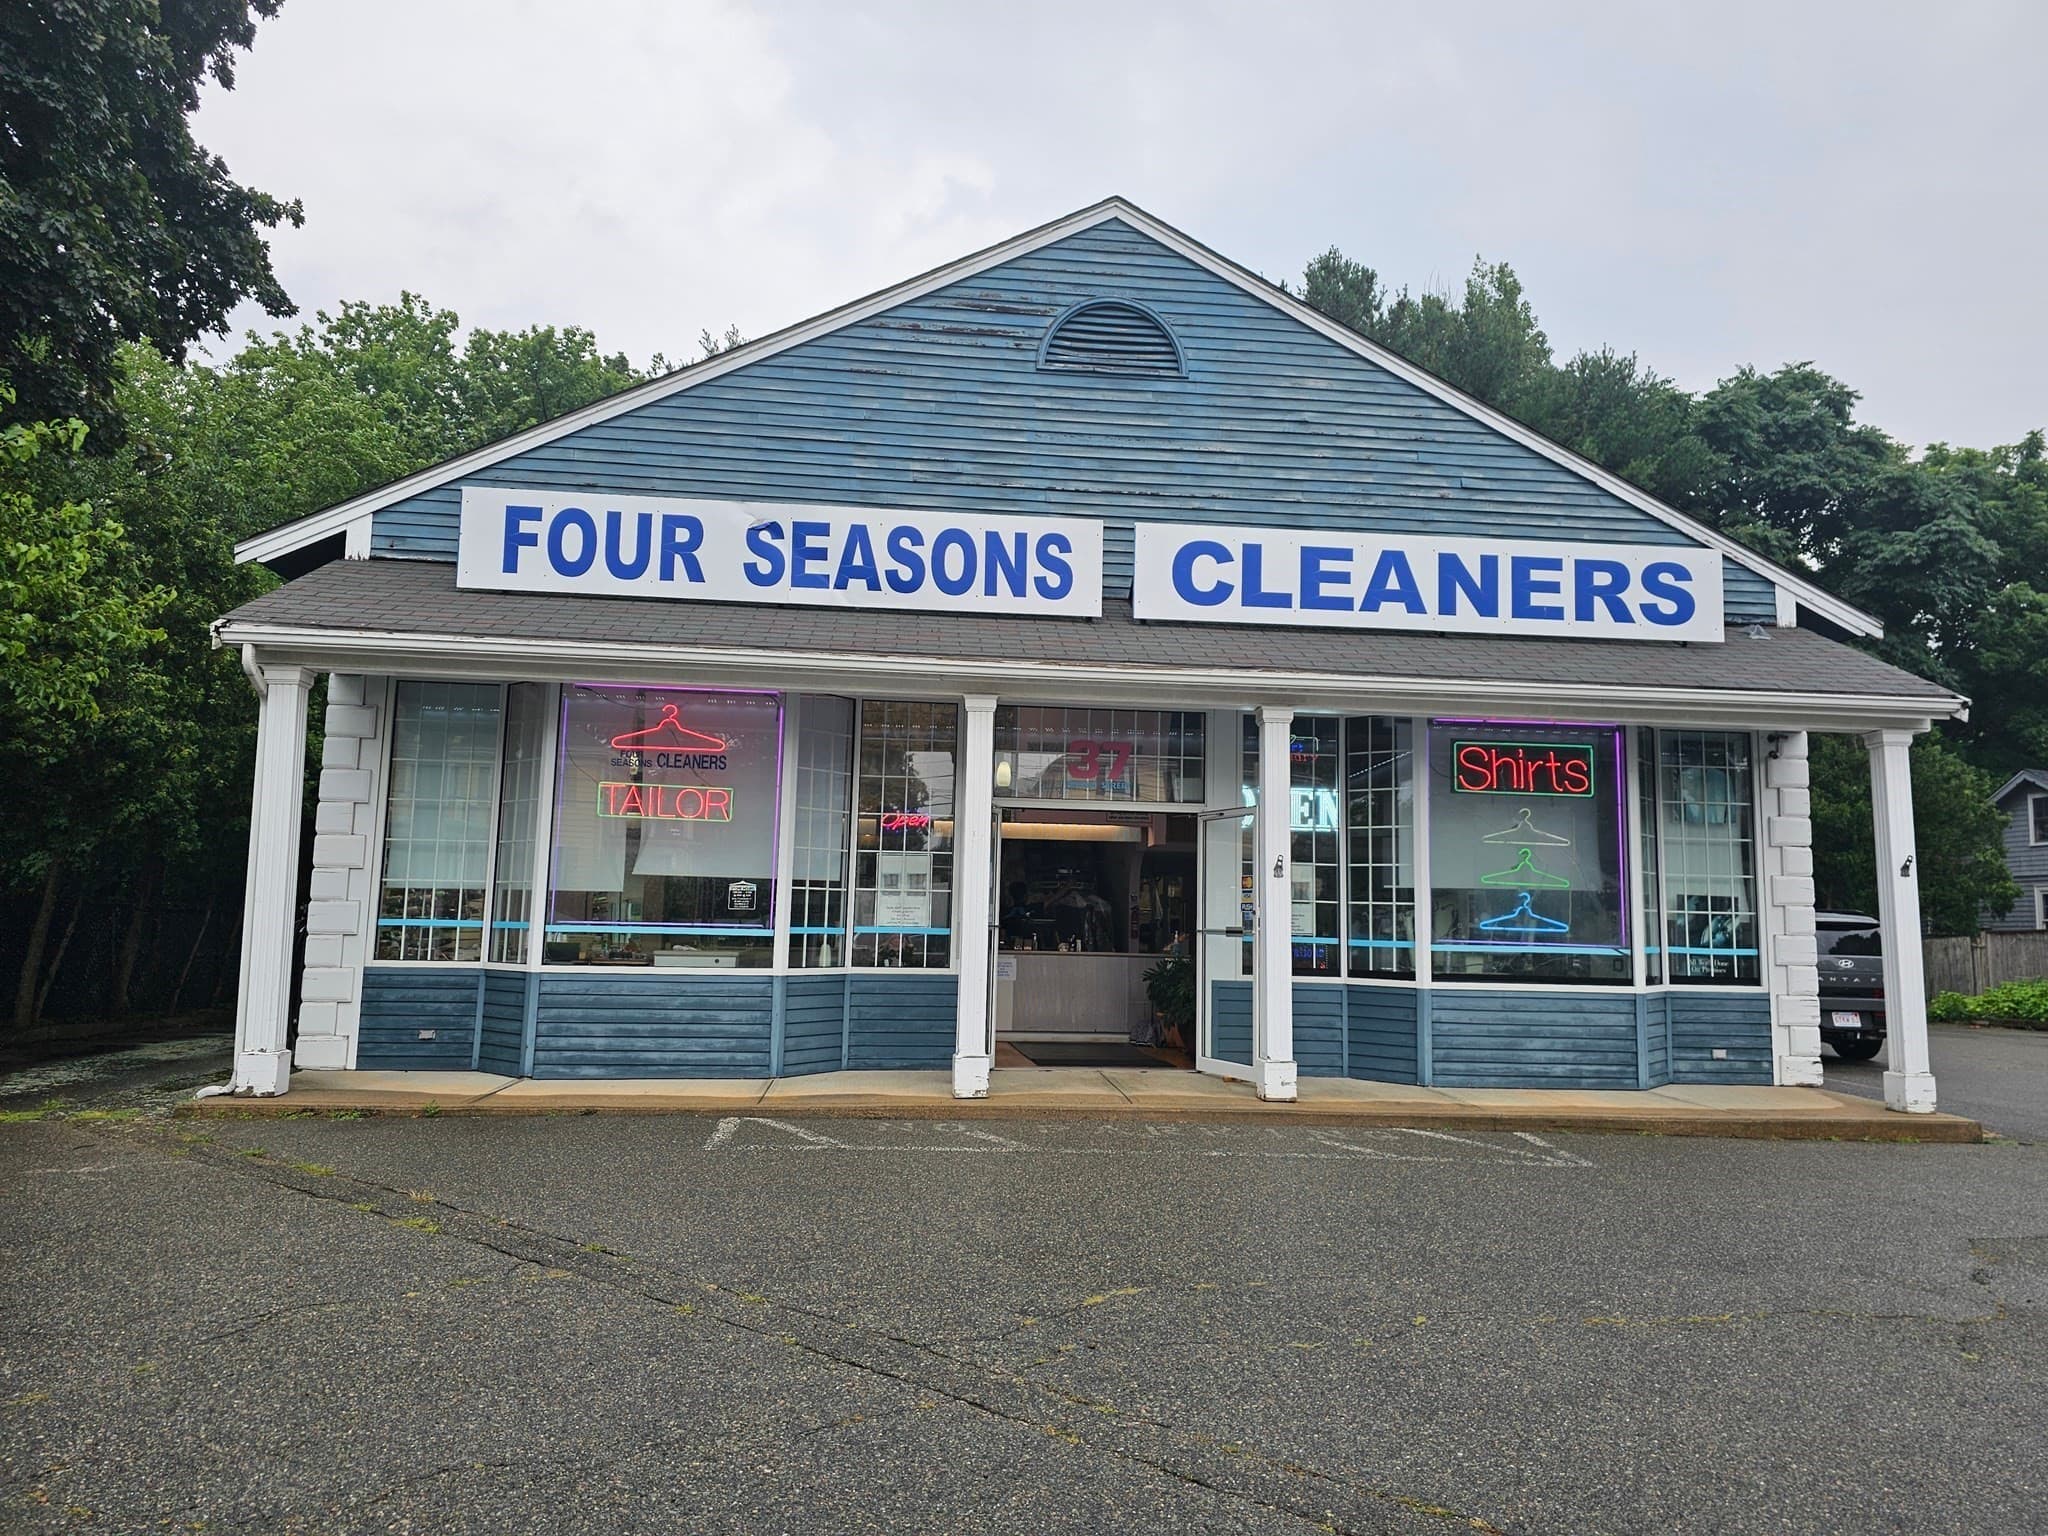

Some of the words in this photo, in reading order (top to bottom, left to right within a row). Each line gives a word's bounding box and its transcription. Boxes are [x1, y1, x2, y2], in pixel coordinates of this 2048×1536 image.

[502, 505, 706, 584] FOUR
[743, 520, 1074, 600] SEASONS
[1171, 540, 1697, 627] CLEANERS
[611, 758, 653, 767] SEASONS
[657, 752, 727, 770] CLEANERS
[1067, 740, 1132, 779] 37
[1458, 746, 1590, 792] Shirts
[600, 783, 730, 821] TAILOR
[881, 811, 930, 830] Open
